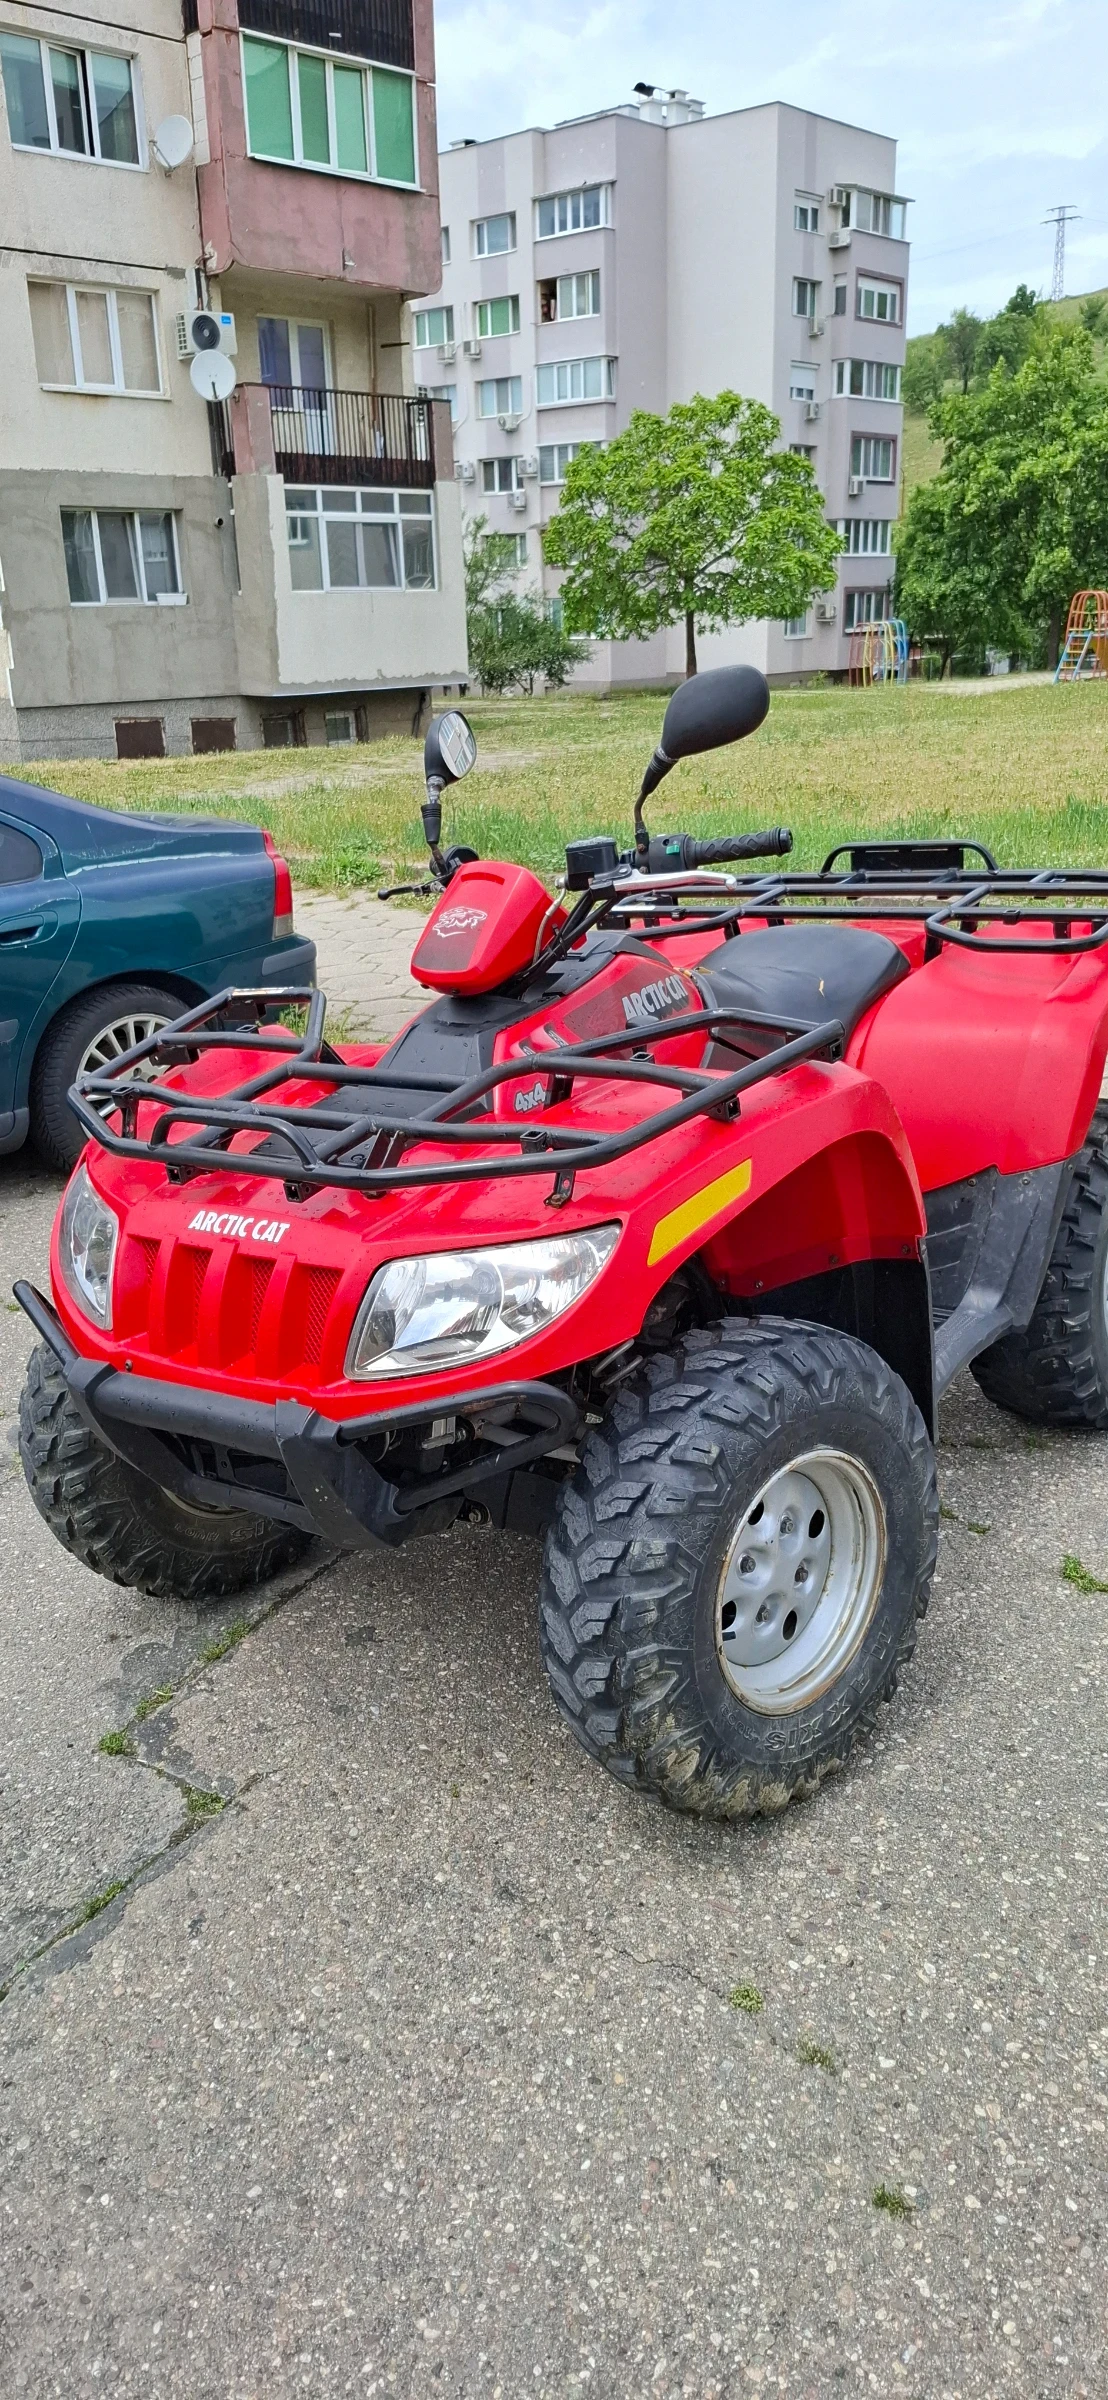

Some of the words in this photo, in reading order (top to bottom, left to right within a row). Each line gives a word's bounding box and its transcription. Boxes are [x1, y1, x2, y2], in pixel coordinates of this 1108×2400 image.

[622, 980, 672, 1020] ARCTIC
[514, 1082, 547, 1112] 4x4
[188, 1210, 254, 1237] ARCTIC
[252, 1219, 291, 1243] CAT
[764, 1616, 892, 1750] MAXXIS
